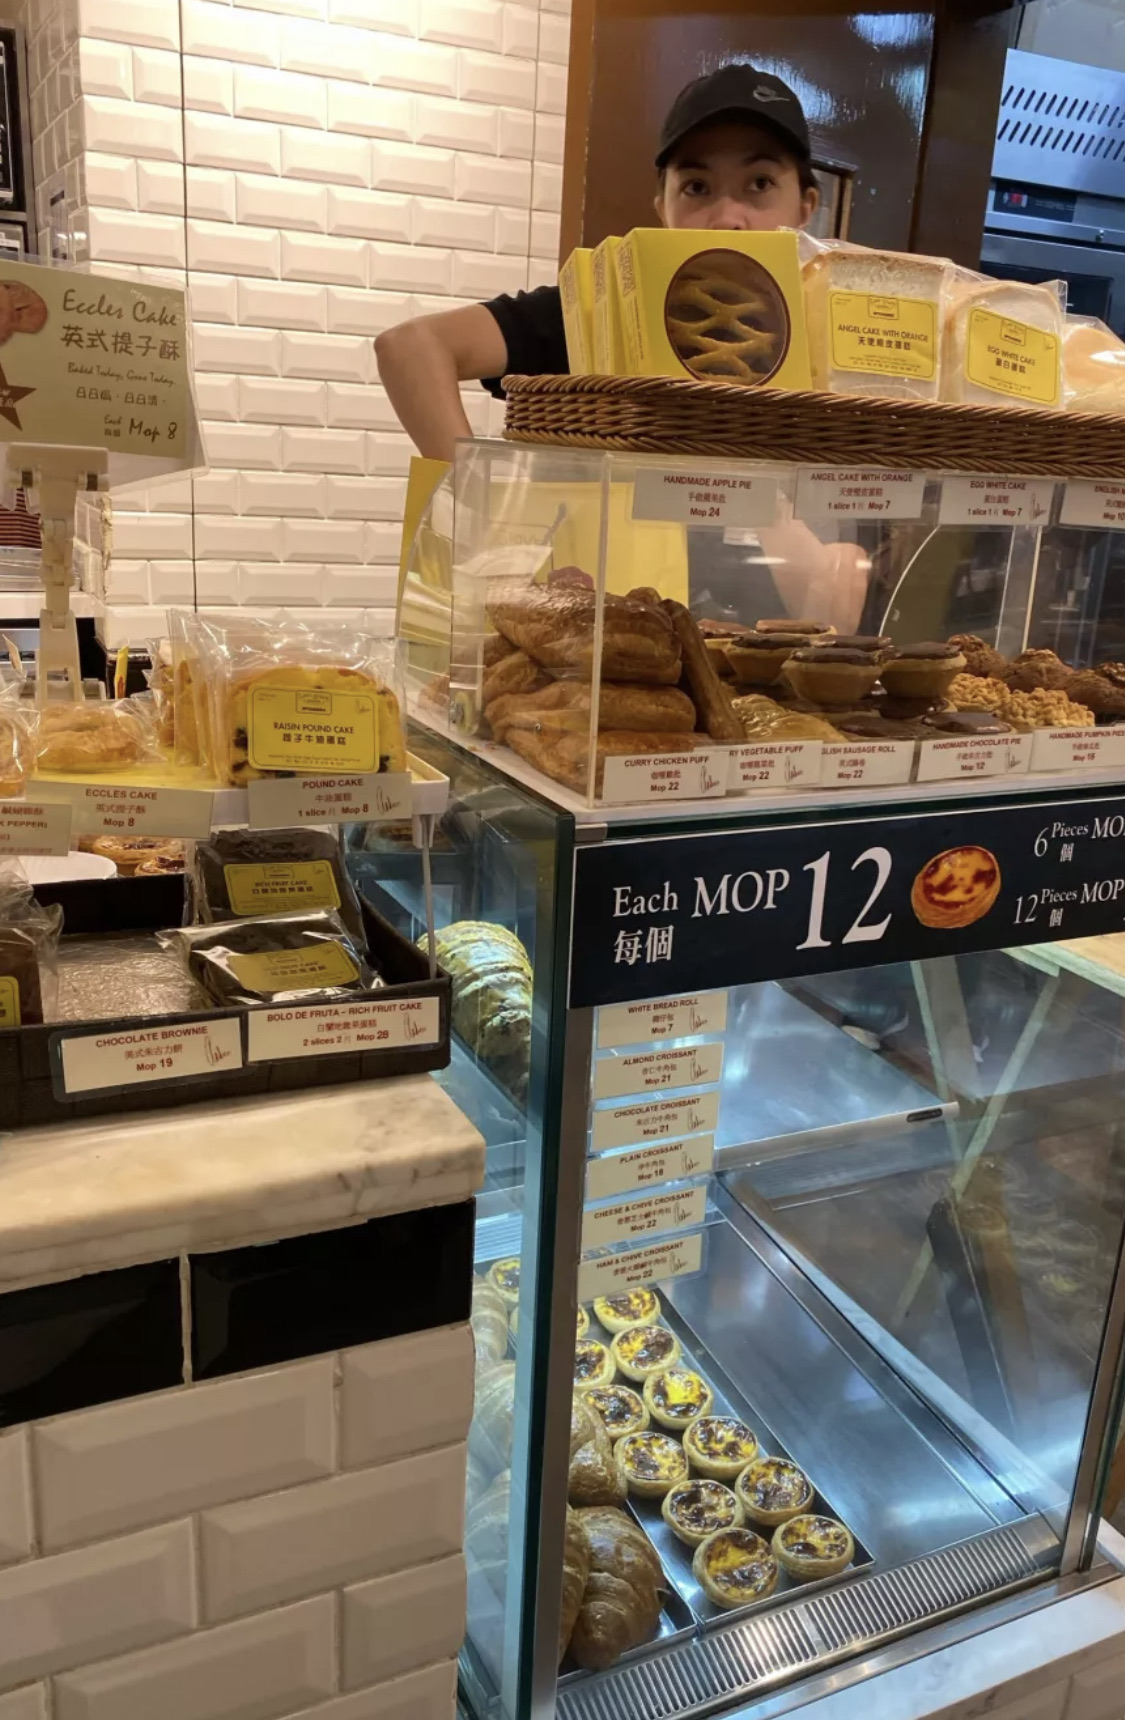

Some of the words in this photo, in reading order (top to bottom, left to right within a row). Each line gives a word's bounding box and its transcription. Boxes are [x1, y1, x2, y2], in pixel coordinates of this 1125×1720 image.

[63, 289, 123, 319] Eccles
[132, 301, 177, 326] Cake
[838, 324, 860, 333] ANGEL
[862, 327, 880, 335] CAKE
[900, 332, 928, 342] ORANGE
[61, 324, 180, 360] 英式提子酥
[987, 345, 1000, 355] EGG
[1001, 349, 1019, 360] WHITE
[1020, 354, 1036, 366] CAKE
[129, 418, 160, 442] Mop
[167, 422, 178, 439] 8
[664, 475, 710, 486] HANDMADE
[712, 477, 738, 488] APPLE
[739, 480, 752, 489] PIE
[811, 473, 837, 481] ANGEL
[838, 473, 860, 482] CAKE
[861, 474, 880, 482] WITH
[882, 474, 913, 482] ORANGE
[970, 481, 985, 489] EGG
[986, 481, 1007, 489] WHITE
[1008, 482, 1026, 490] CAKE
[833, 502, 850, 510] slice
[868, 502, 883, 511] Mop
[885, 500, 891, 510] 7
[690, 508, 706, 517] Mop
[708, 507, 720, 517] 24
[1002, 508, 1016, 517] Mop
[1017, 507, 1022, 516] 7
[274, 722, 300, 731] RAISIN
[302, 723, 332, 732] POUND
[334, 725, 354, 734] CAKE
[1049, 731, 1082, 740] HANDMADE
[1083, 730, 1110, 738] PUMPKIN
[741, 747, 783, 756] VEGETABLE
[785, 745, 804, 753] PUFF
[842, 746, 875, 754] SAUSAGE
[877, 745, 896, 753] ROLL
[933, 741, 969, 750] HANDMADE
[970, 739, 1008, 748] CHOCOLATE
[624, 758, 651, 767] CURRY
[653, 757, 688, 766] CHICKEN
[689, 756, 709, 764] PUFF
[961, 763, 975, 771] Mop
[976, 761, 985, 770] 12
[743, 773, 757, 781] Mop
[759, 771, 770, 780] 22
[853, 770, 863, 779] 22
[302, 780, 336, 789] POUND
[338, 778, 363, 787] CAKE
[651, 784, 666, 792] Mop
[668, 782, 679, 791] 22
[85, 788, 127, 799] ECCLES
[129, 791, 157, 800] CAKE
[305, 807, 326, 816] slice
[341, 806, 360, 815] Mop
[362, 803, 369, 812] 8
[103, 818, 124, 827] Mop
[128, 817, 135, 827] 8
[1034, 827, 1049, 857] 6
[1051, 822, 1089, 838] Pieces
[1091, 815, 1125, 839] MO
[613, 884, 678, 918] Each
[691, 868, 790, 918] MOP
[796, 846, 893, 951] 12
[1013, 894, 1038, 924] 12
[1041, 888, 1078, 904] Pieces
[1080, 879, 1125, 904] MOP
[613, 925, 674, 966] 每個
[267, 1011, 293, 1022] BOLO
[295, 1011, 307, 1019] DE
[310, 1009, 339, 1018] FRUTA
[349, 1006, 370, 1015] RICH
[372, 1004, 397, 1014] FRUIT
[399, 1002, 422, 1012] CAKE
[628, 1003, 651, 1013] WHITE
[653, 1001, 678, 1010] BREAD
[651, 1026, 666, 1034] Mop
[96, 1032, 159, 1048] CHOCOLATE
[311, 1036, 334, 1047] slices
[357, 1032, 375, 1043] Mop
[376, 1030, 389, 1040] 28
[622, 1055, 654, 1066] ALMOND
[656, 1050, 697, 1061] CROISSANT
[136, 1061, 157, 1072] Mop
[159, 1058, 173, 1069] 19
[661, 1074, 671, 1083] 21
[614, 1105, 658, 1118] CHOCOLATE
[660, 1098, 700, 1110] CROISSANT
[643, 1128, 658, 1136] Mop
[659, 1125, 669, 1133] 21
[619, 1152, 641, 1164] PLAIN
[642, 1144, 683, 1158] CROISSANT
[638, 1173, 653, 1181] Mop
[594, 1206, 624, 1219] CHEESE
[631, 1201, 652, 1211] CHIVE
[654, 1191, 694, 1205] CROISSANT
[630, 1224, 646, 1232] Mop
[647, 1220, 657, 1229] 22
[597, 1259, 613, 1269] HAM
[621, 1252, 642, 1263] CHIVE
[644, 1242, 684, 1257] CROISSANT
[626, 1274, 642, 1283] Mop
[643, 1270, 653, 1279] 22
